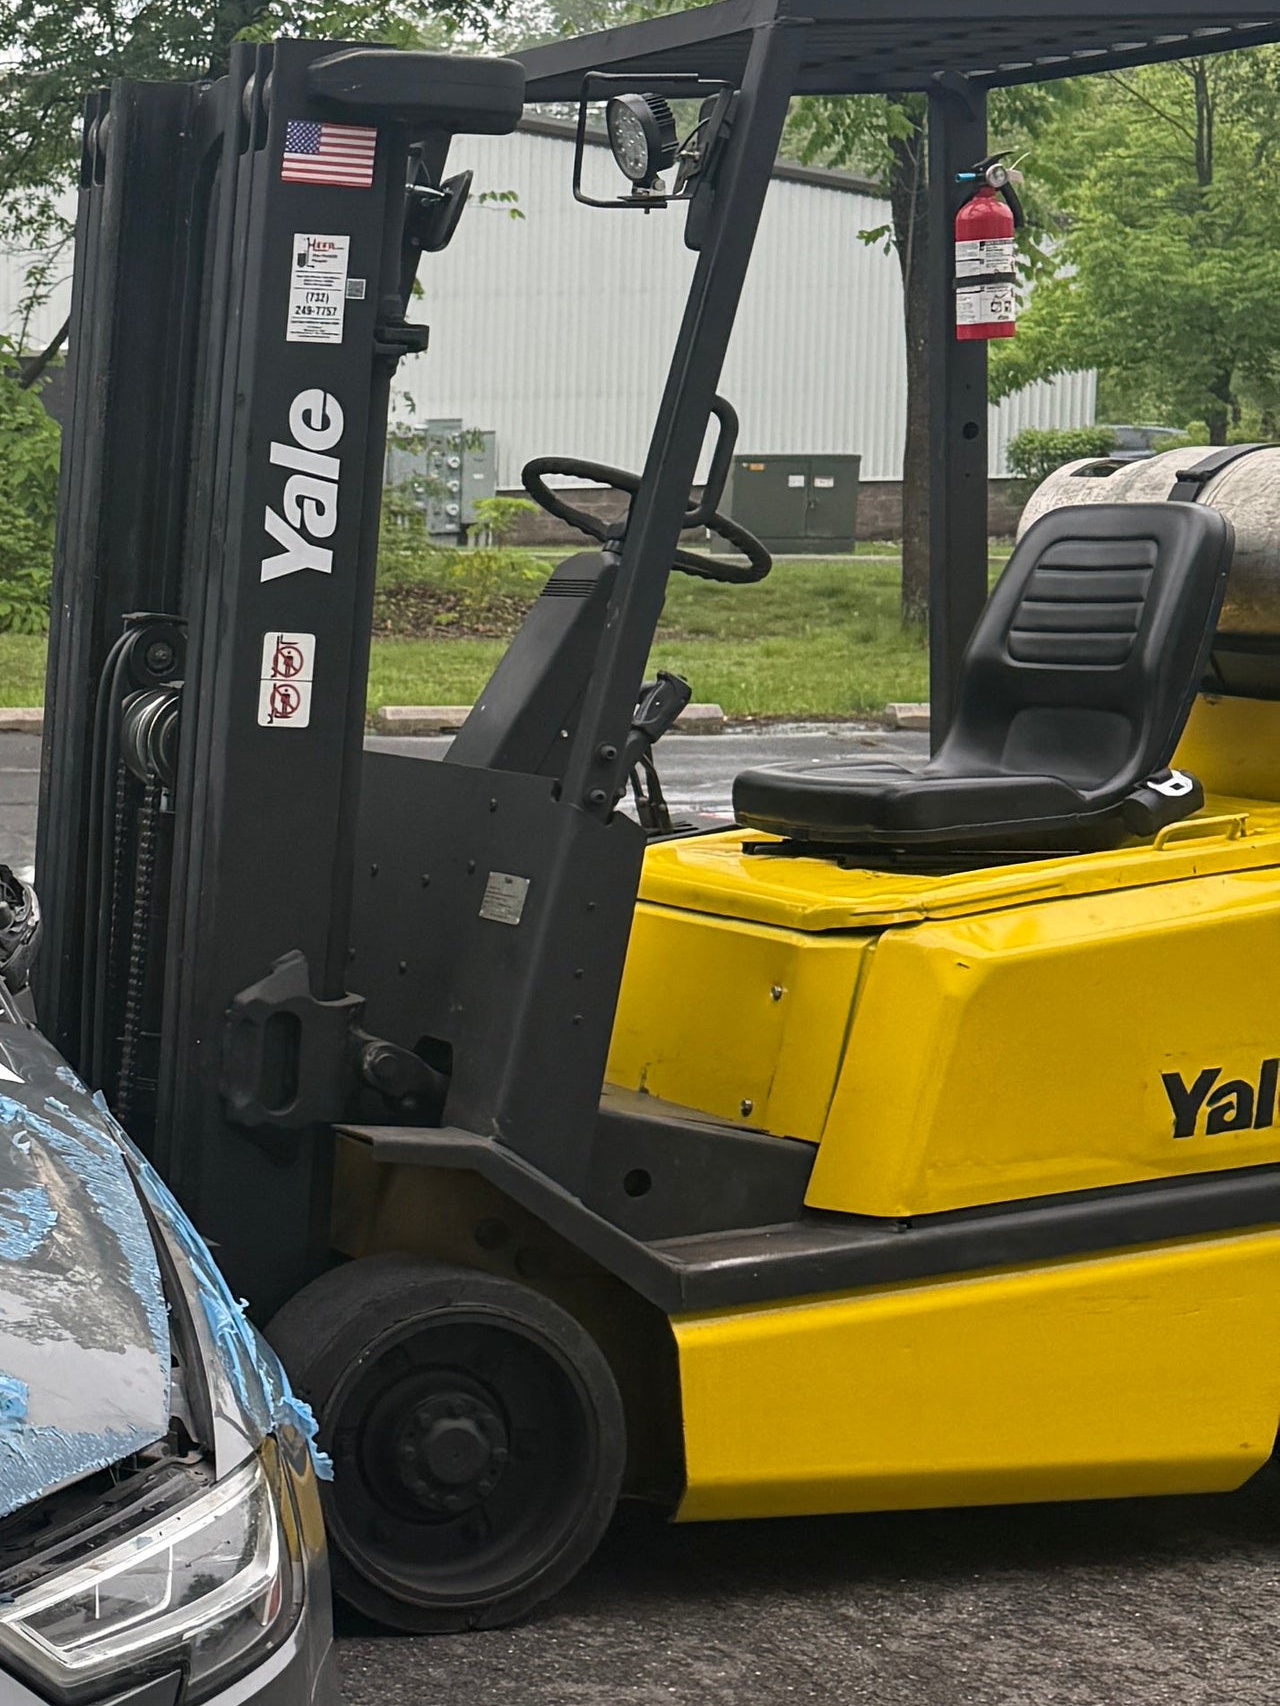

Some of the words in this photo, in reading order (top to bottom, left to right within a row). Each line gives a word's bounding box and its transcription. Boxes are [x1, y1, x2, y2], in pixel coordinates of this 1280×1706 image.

[296, 306, 337, 316] 249-7757
[306, 292, 329, 304] (732)
[261, 388, 344, 583] Yale
[1160, 1058, 1280, 1139] Yal
